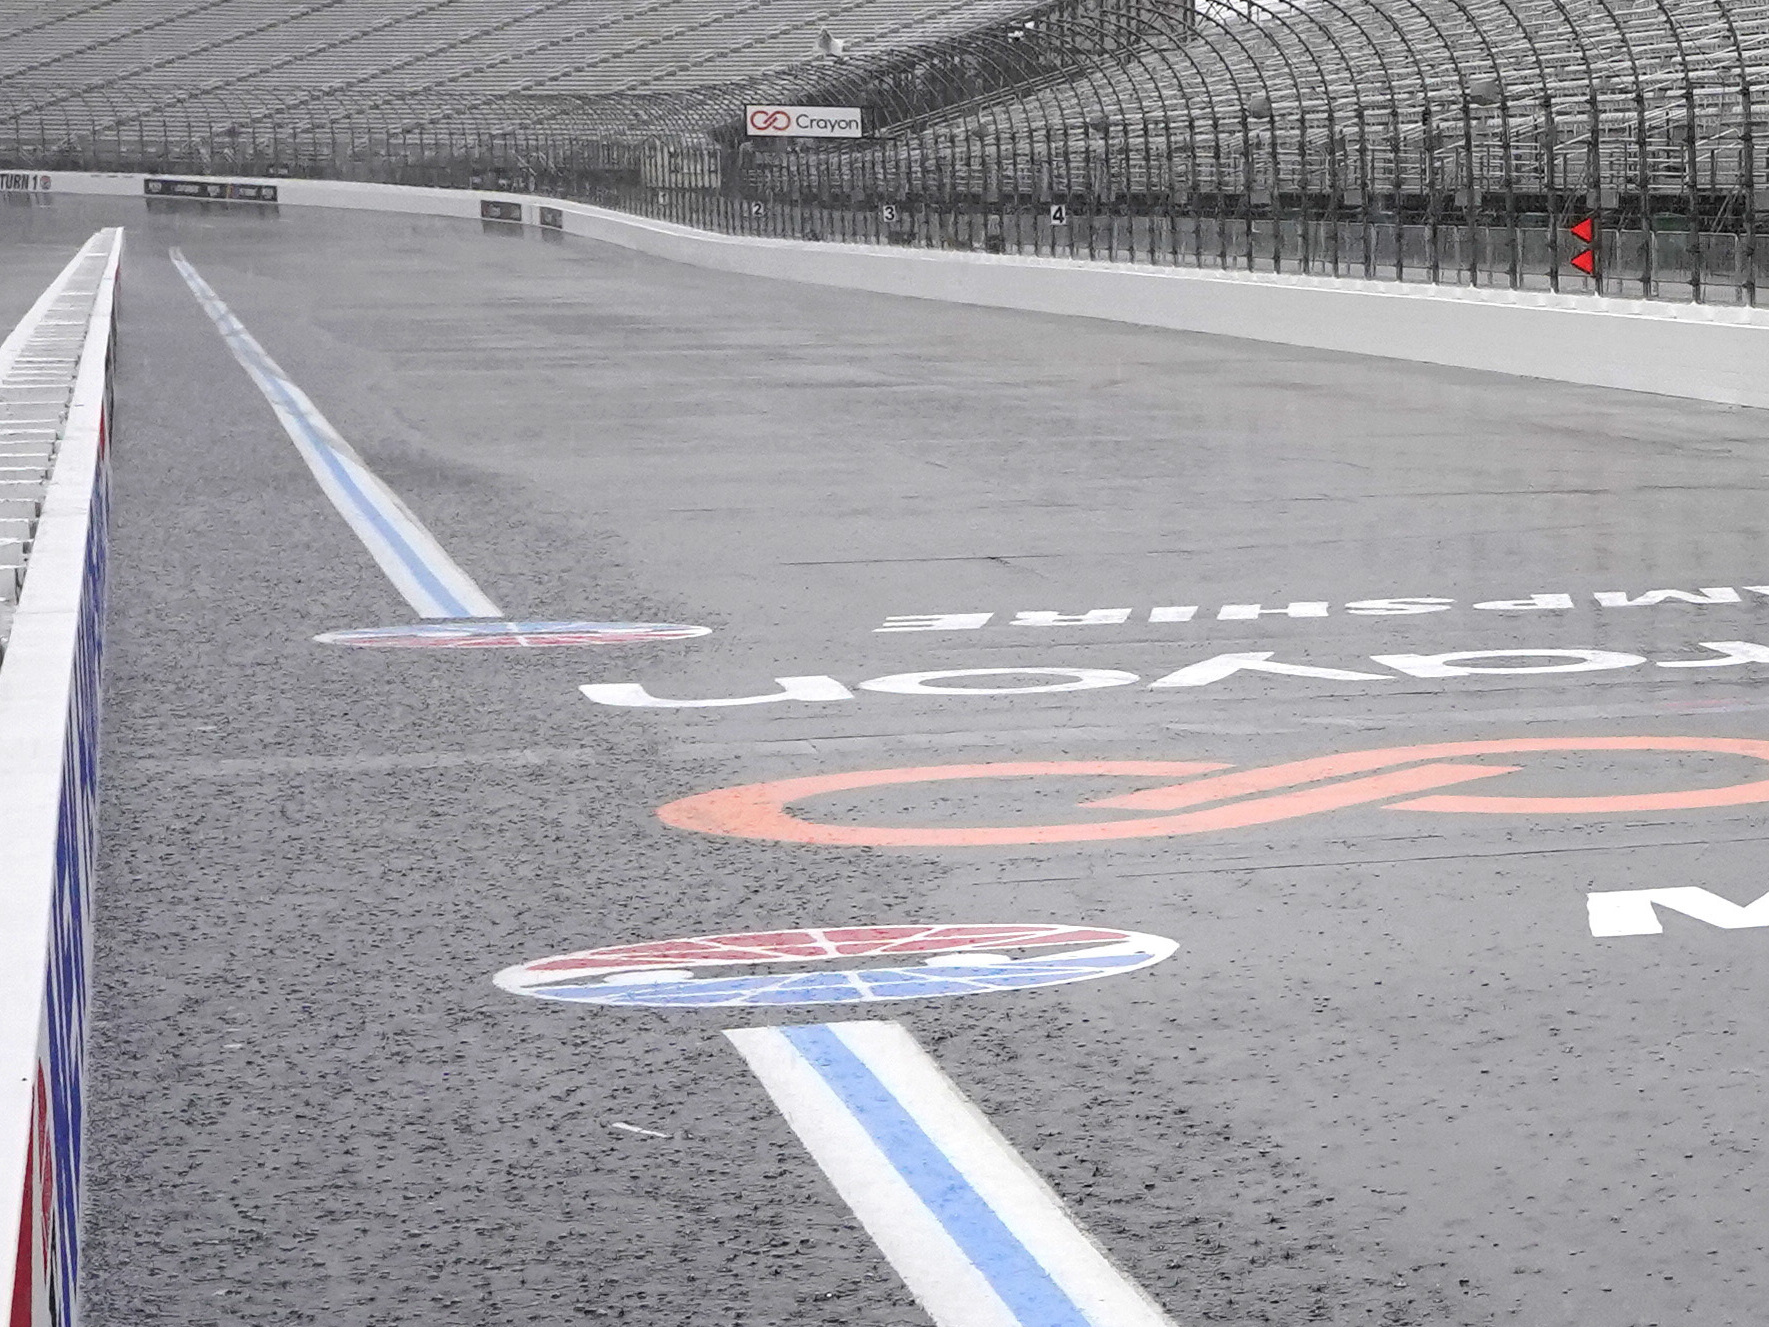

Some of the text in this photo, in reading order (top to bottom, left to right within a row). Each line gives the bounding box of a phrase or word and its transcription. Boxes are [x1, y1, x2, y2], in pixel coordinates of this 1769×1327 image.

[795, 113, 860, 133] Crayon
[753, 202, 762, 215] 2
[885, 206, 895, 221] 3
[1053, 206, 1064, 223] 4
